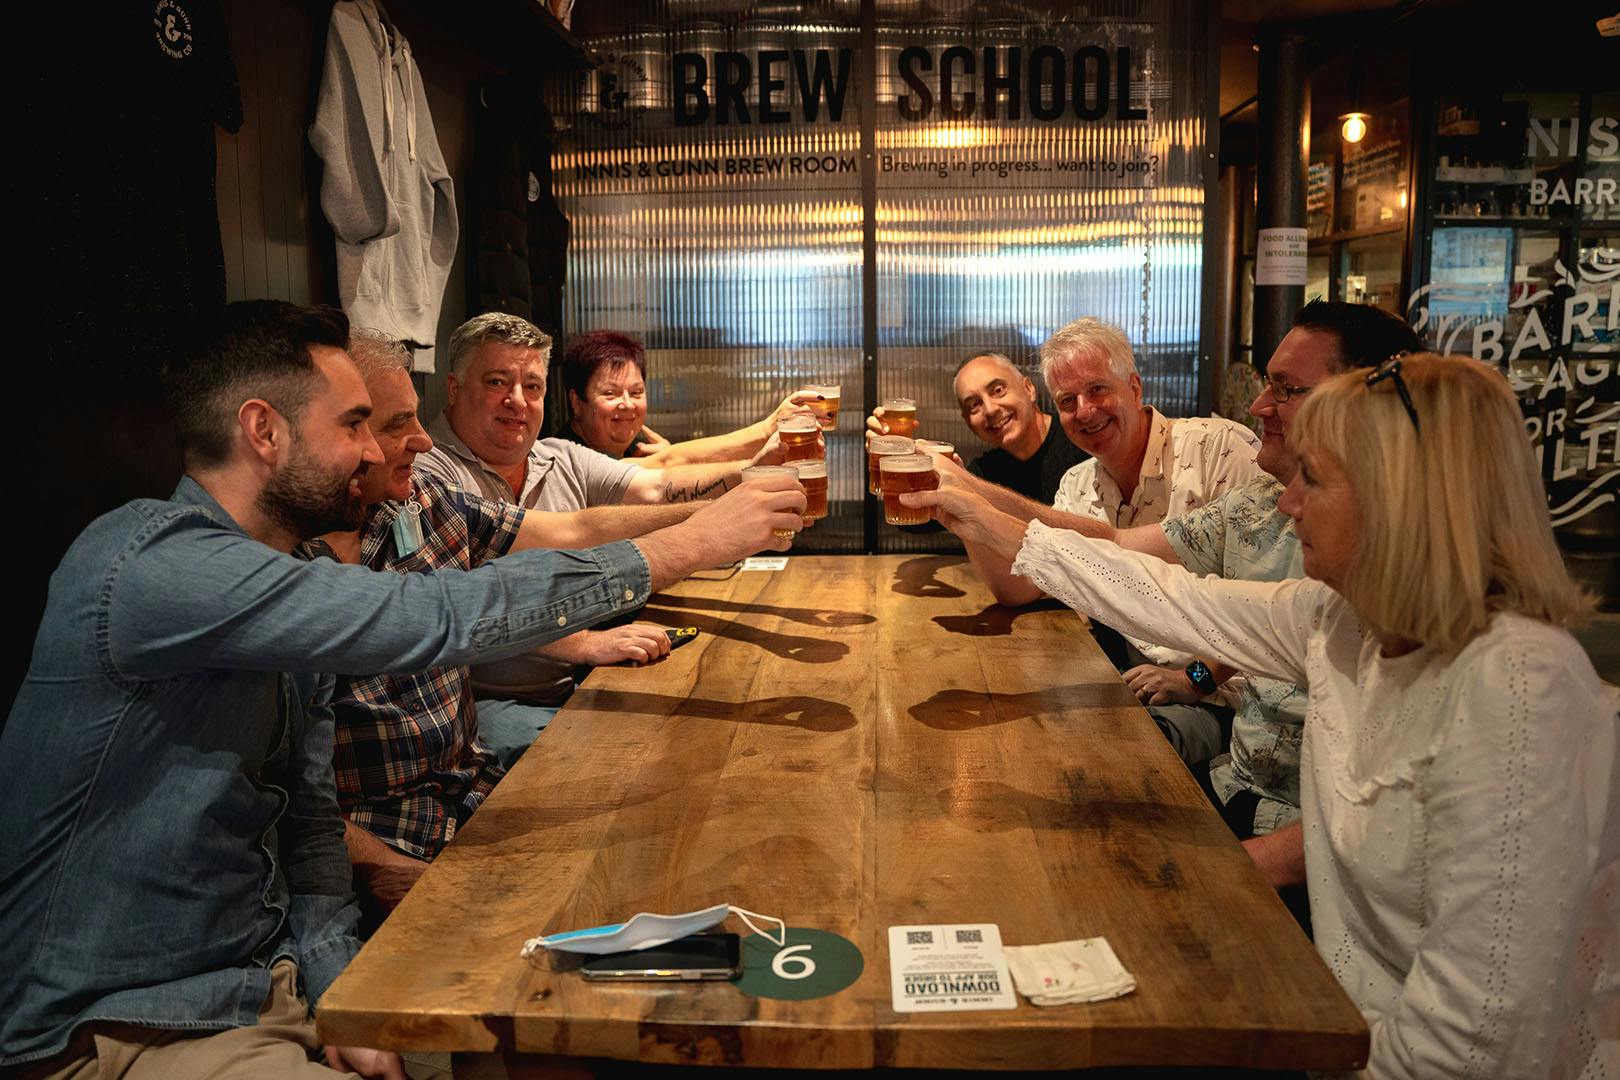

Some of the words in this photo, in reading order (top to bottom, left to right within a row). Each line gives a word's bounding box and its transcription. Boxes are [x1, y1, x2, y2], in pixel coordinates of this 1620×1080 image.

[673, 49, 853, 126] BREW
[897, 45, 1148, 121] SCHOOL
[576, 161, 631, 180] INNIS
[638, 160, 651, 177] &
[656, 159, 719, 178] GUNN
[725, 157, 784, 175] BREW
[790, 155, 858, 174] ROOM
[882, 155, 948, 178] Brewing
[952, 156, 967, 172] in
[971, 159, 1053, 178] progress...
[1057, 157, 1097, 172] want
[1100, 158, 1117, 172] to
[1118, 155, 1160, 178] join?
[1530, 177, 1620, 206] BARR
[905, 981, 1000, 995] DOWNLOAD
